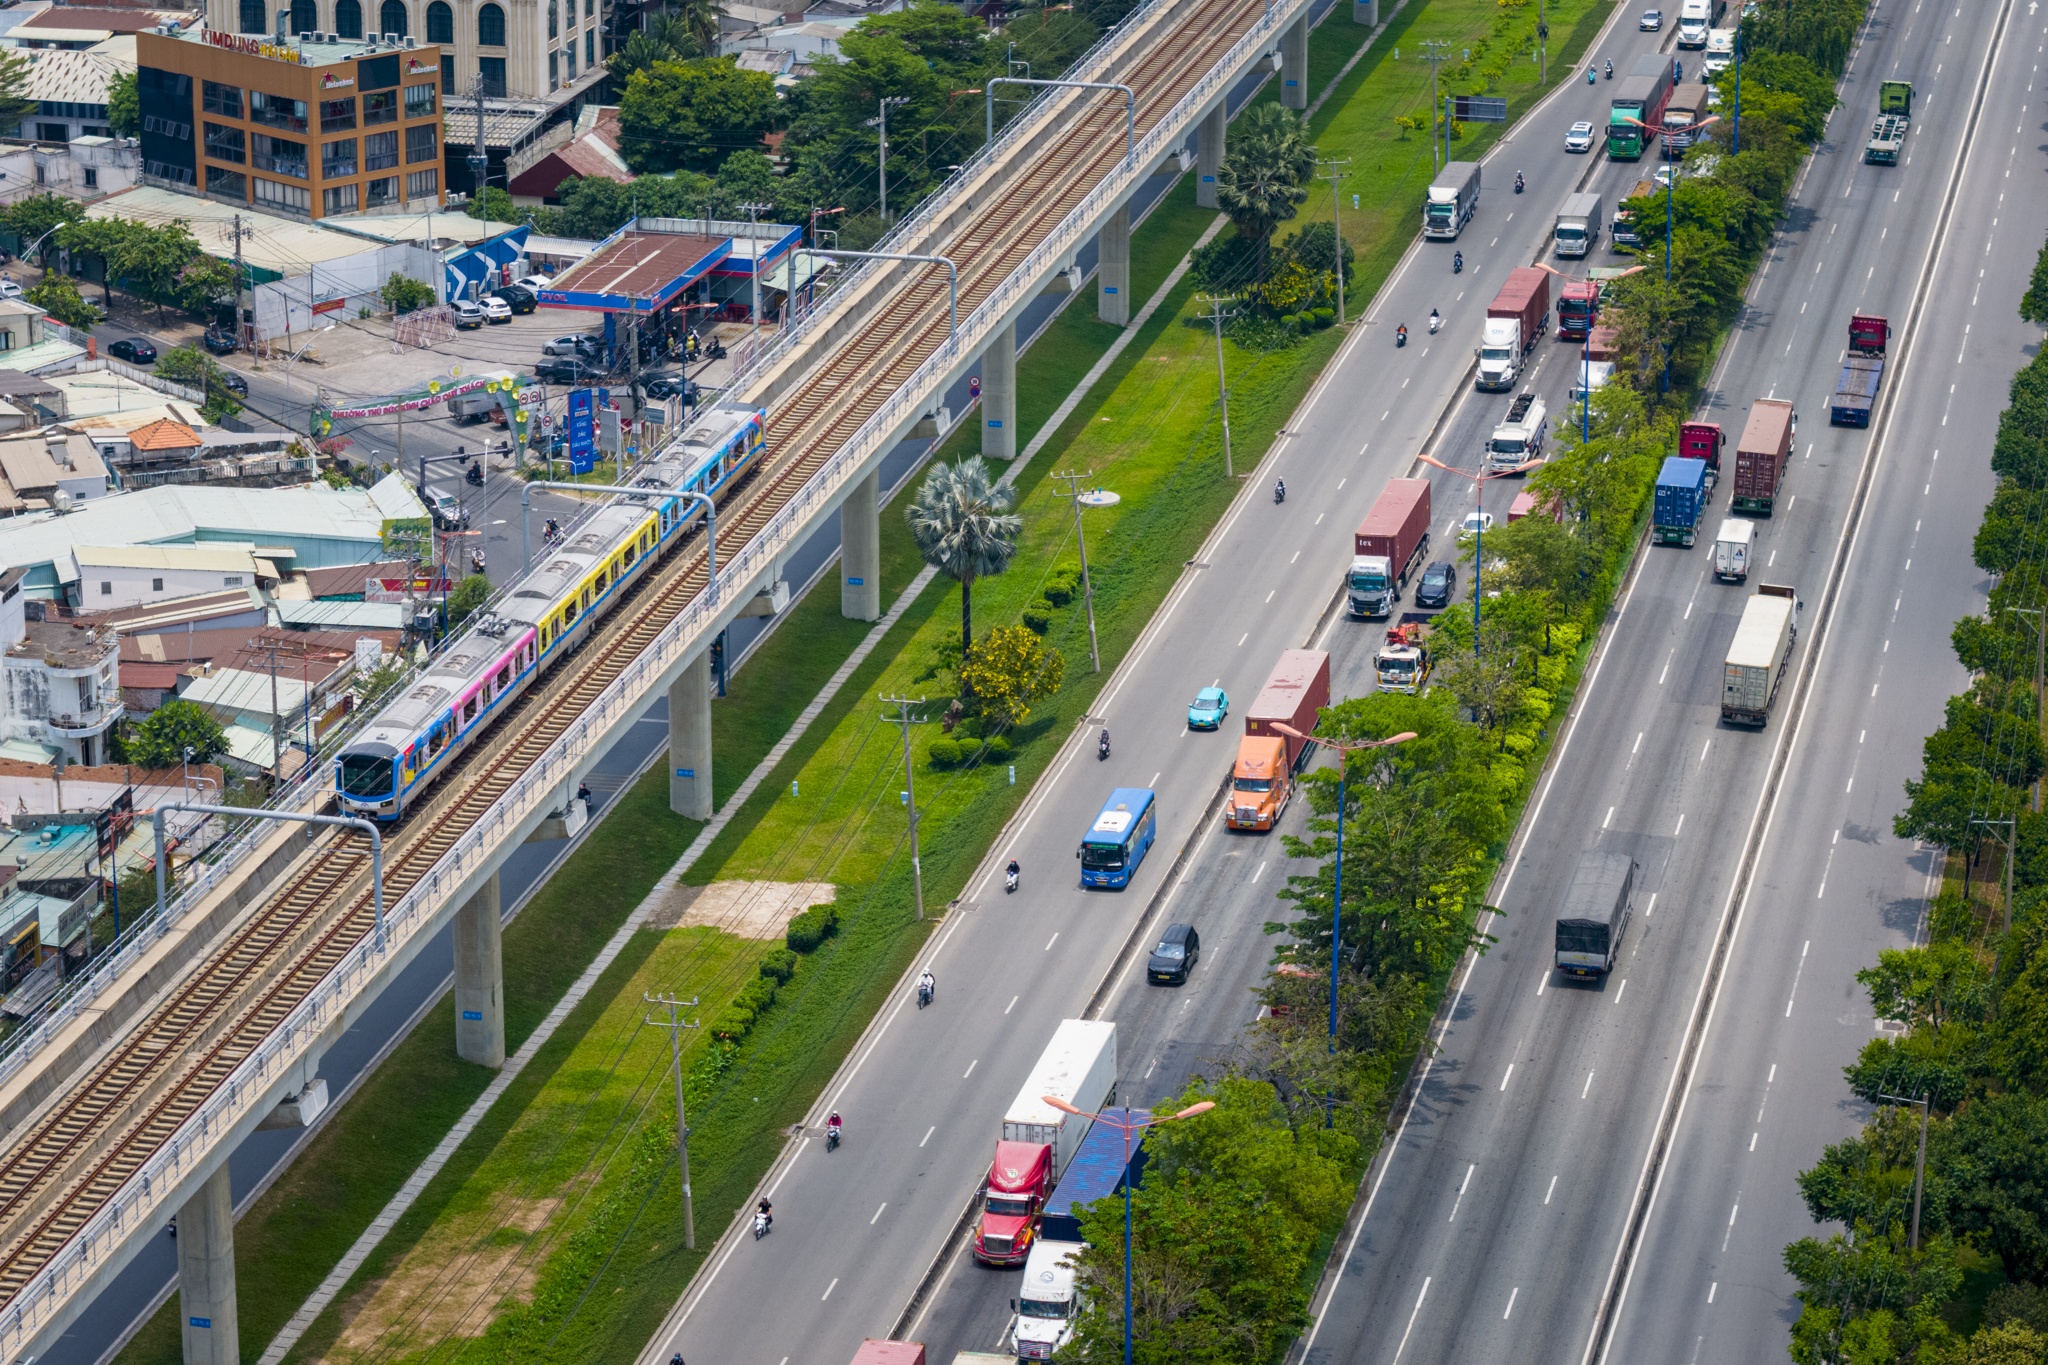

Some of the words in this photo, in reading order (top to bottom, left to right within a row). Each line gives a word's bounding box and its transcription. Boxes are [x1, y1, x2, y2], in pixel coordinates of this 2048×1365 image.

[410, 64, 438, 75] Heineken
[325, 77, 354, 88] Heineken
[541, 292, 568, 302] PVOIL
[459, 379, 486, 395] KHÁCH
[1360, 539, 1372, 547] tex
